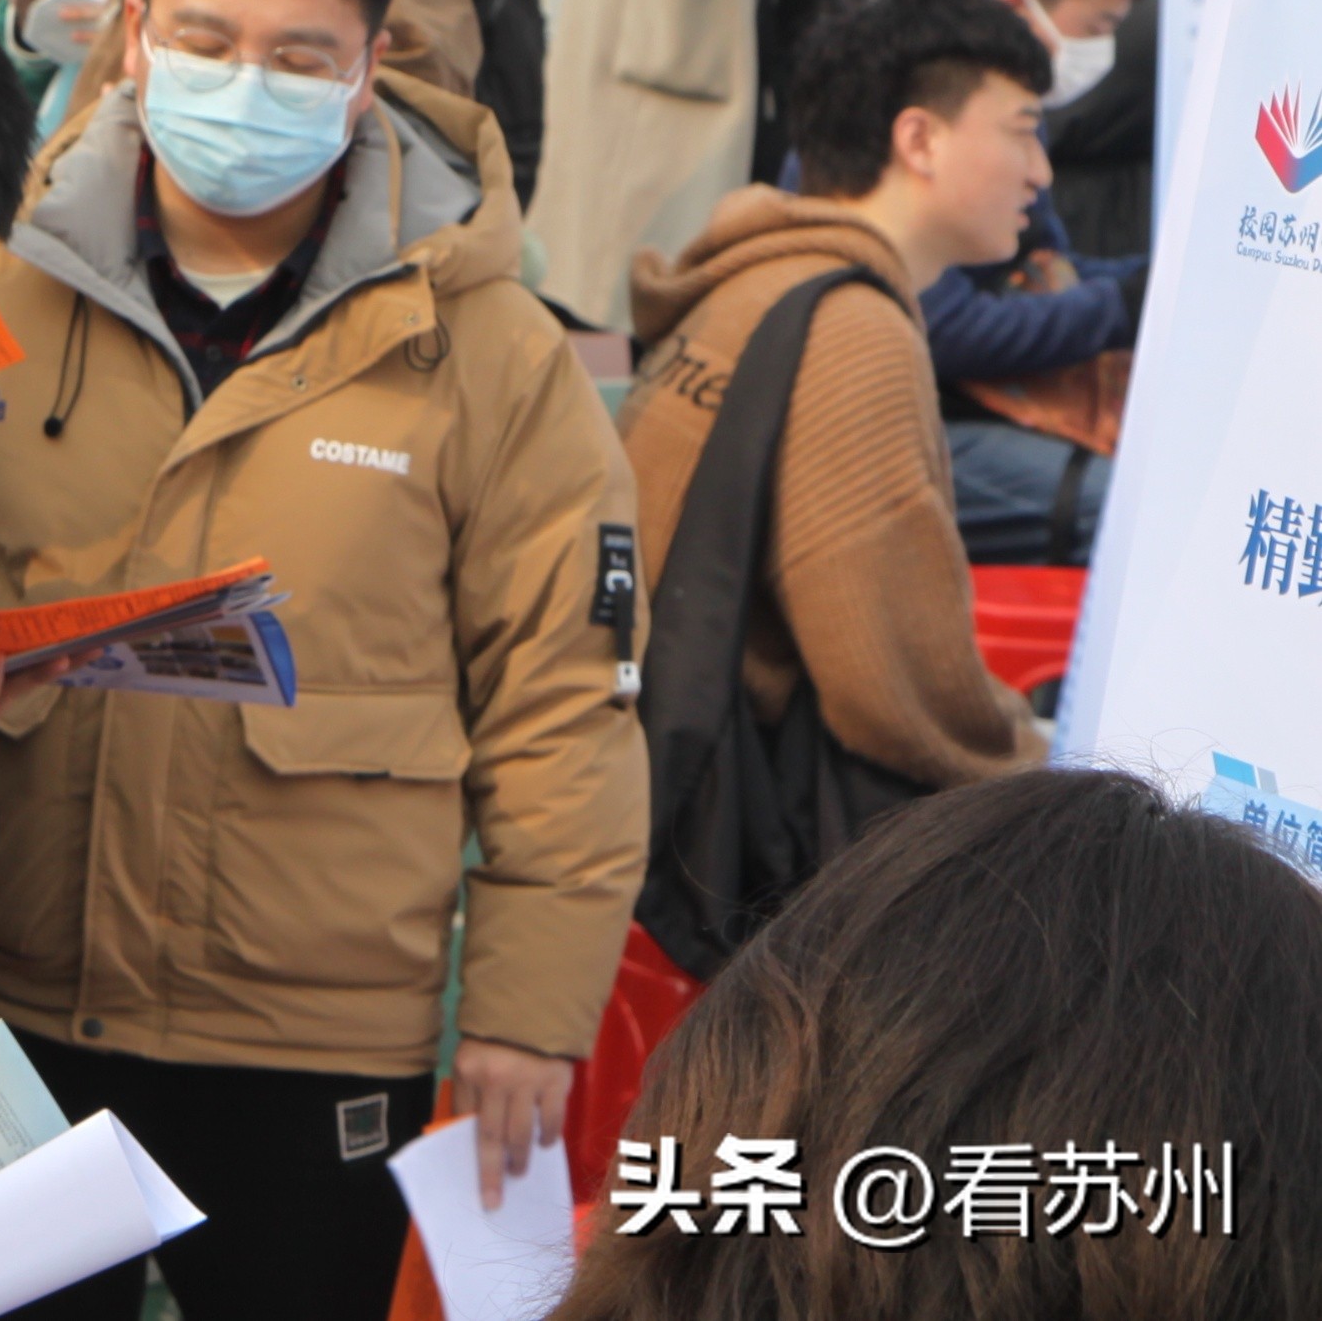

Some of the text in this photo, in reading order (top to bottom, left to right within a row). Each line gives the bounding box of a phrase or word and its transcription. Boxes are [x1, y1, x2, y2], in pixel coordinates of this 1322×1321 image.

[1239, 204, 1322, 253] 校园苏州
[310, 437, 410, 475] COSTAME
